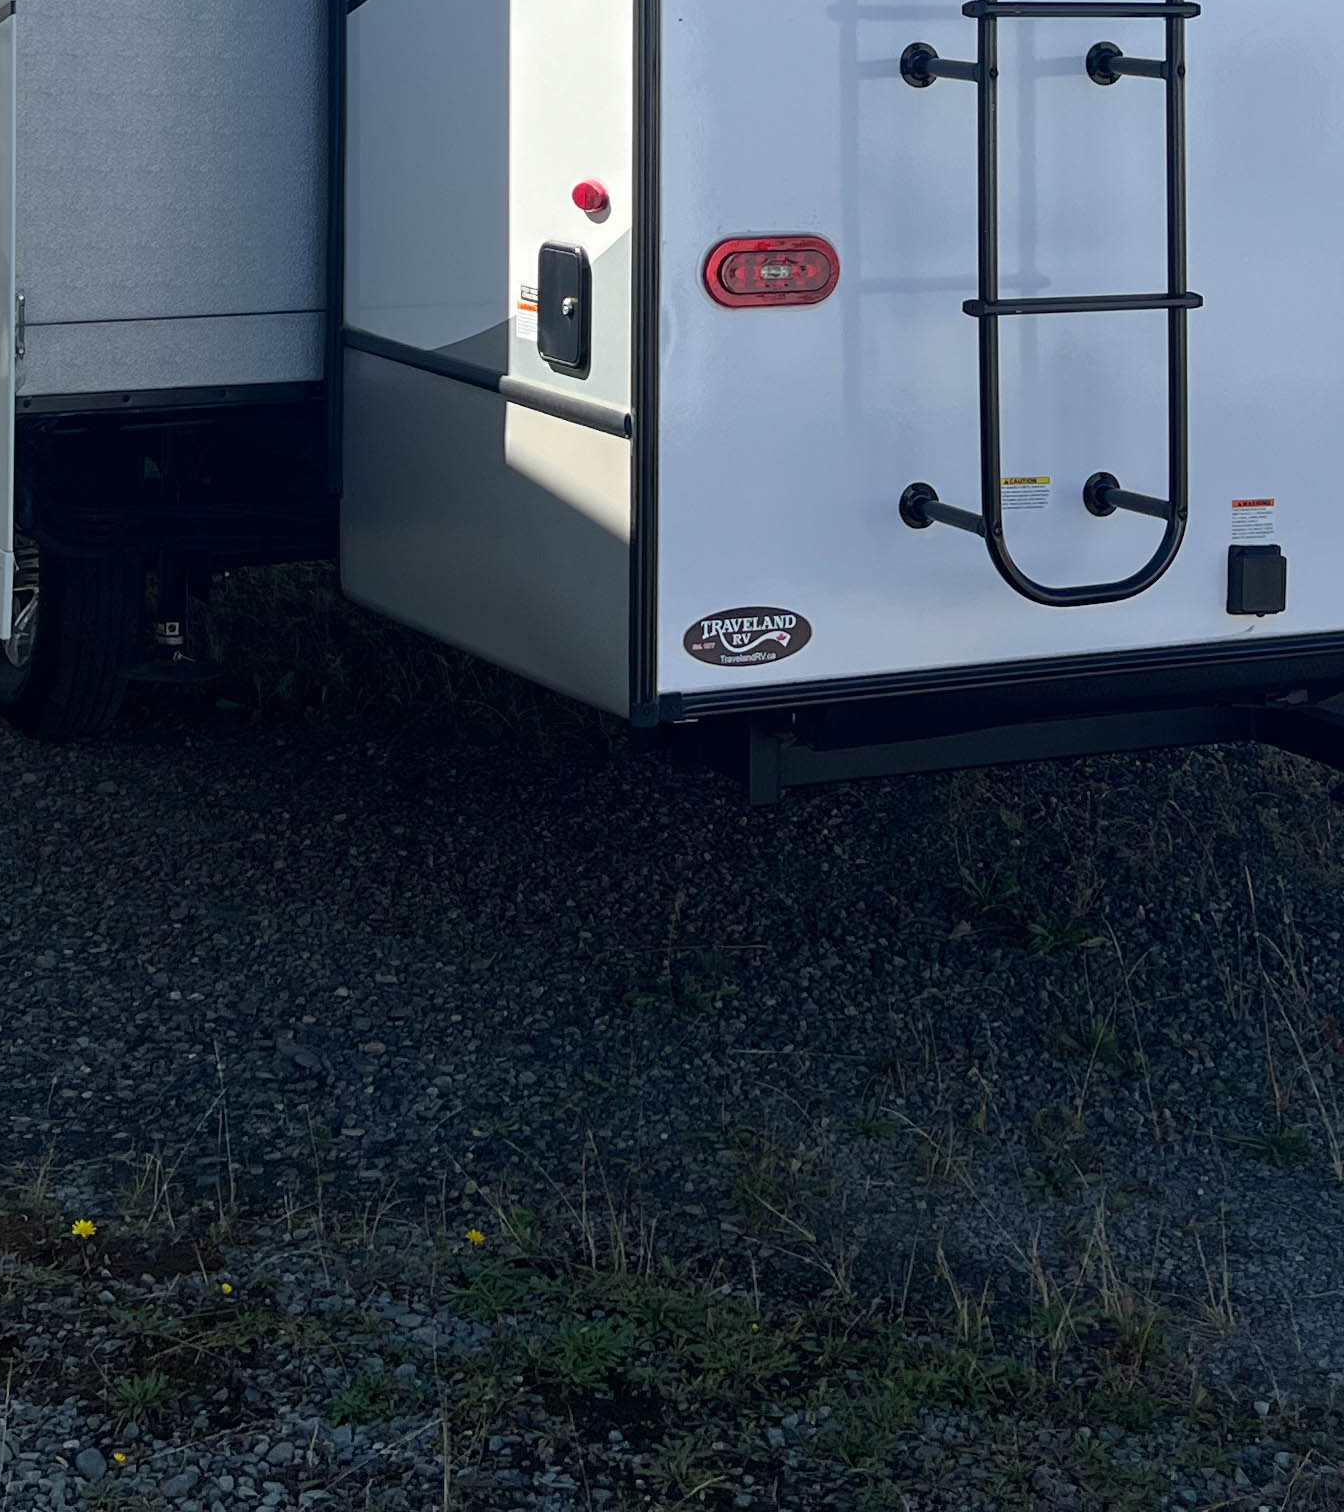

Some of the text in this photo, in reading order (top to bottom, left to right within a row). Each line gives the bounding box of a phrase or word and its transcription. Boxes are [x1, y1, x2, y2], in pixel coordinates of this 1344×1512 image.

[700, 614, 796, 640] TRAVELAND
[732, 633, 751, 646] RV
[720, 651, 777, 664] TravelandRV.ca
